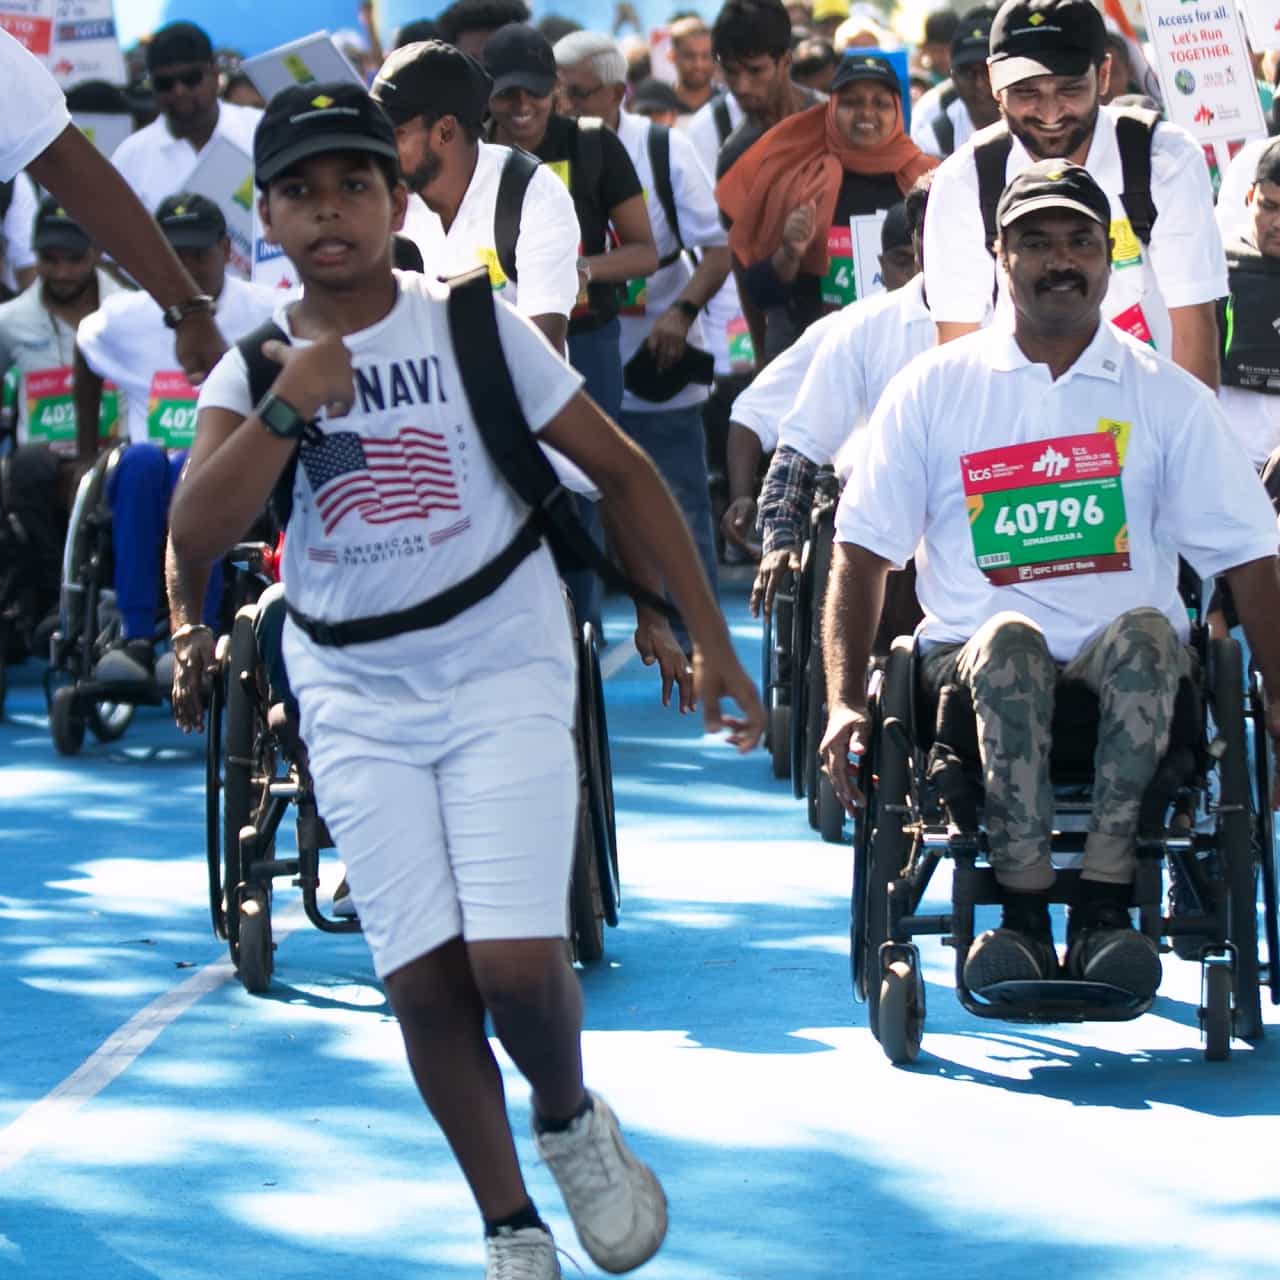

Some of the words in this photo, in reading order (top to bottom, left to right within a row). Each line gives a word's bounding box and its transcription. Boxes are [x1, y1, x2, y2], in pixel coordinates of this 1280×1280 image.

[1158, 14, 1193, 28] Access
[1195, 8, 1212, 22] for
[1172, 30, 1200, 46] Let's
[1200, 28, 1224, 42] Run
[994, 494, 1104, 536] 40796
[343, 534, 423, 556] AMERICAN
[343, 546, 425, 566] TRADITION
